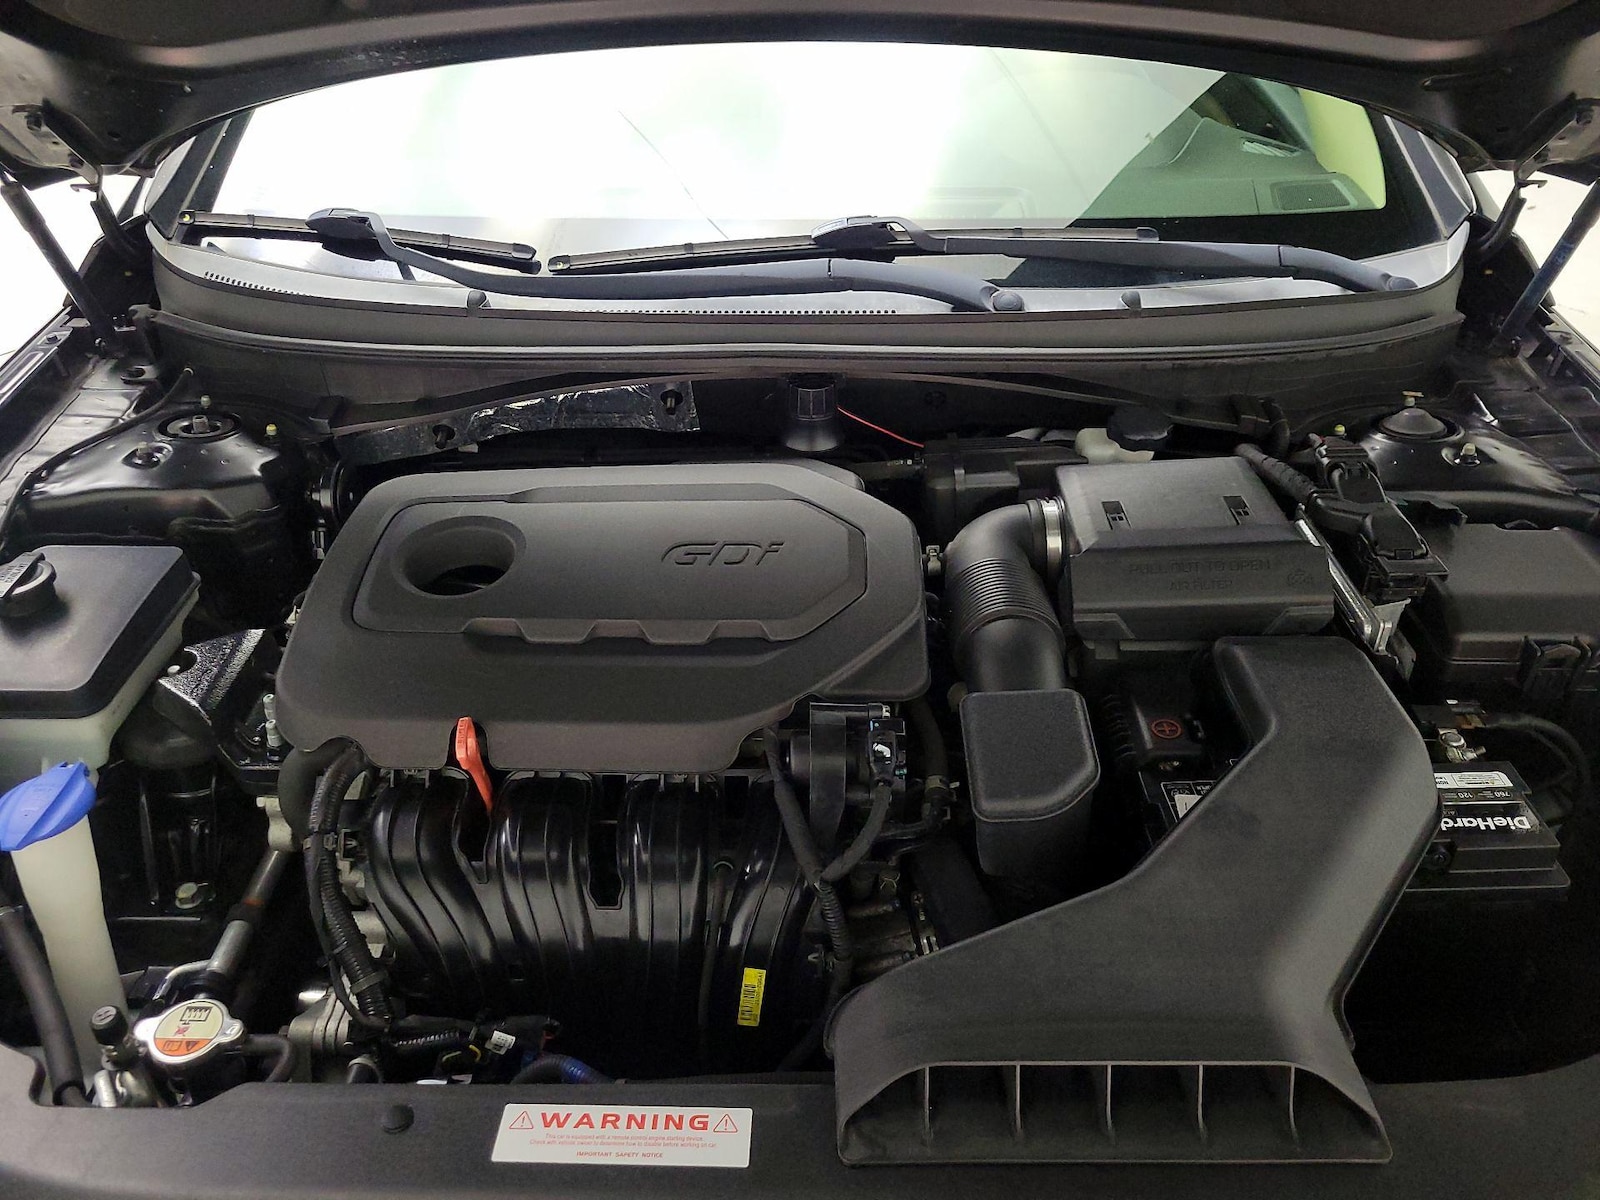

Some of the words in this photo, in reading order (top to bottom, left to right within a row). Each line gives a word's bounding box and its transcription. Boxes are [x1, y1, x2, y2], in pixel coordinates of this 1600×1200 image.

[1129, 562, 1169, 576] PULL
[1170, 560, 1200, 574] OUT
[1205, 560, 1226, 573] TO
[1229, 558, 1271, 572] OPEN
[1168, 579, 1193, 592] AIR
[1193, 578, 1233, 591] FILTER
[1440, 815, 1532, 831] DieHard
[541, 1112, 710, 1131] WARNING
[666, 1135, 686, 1143] starting
